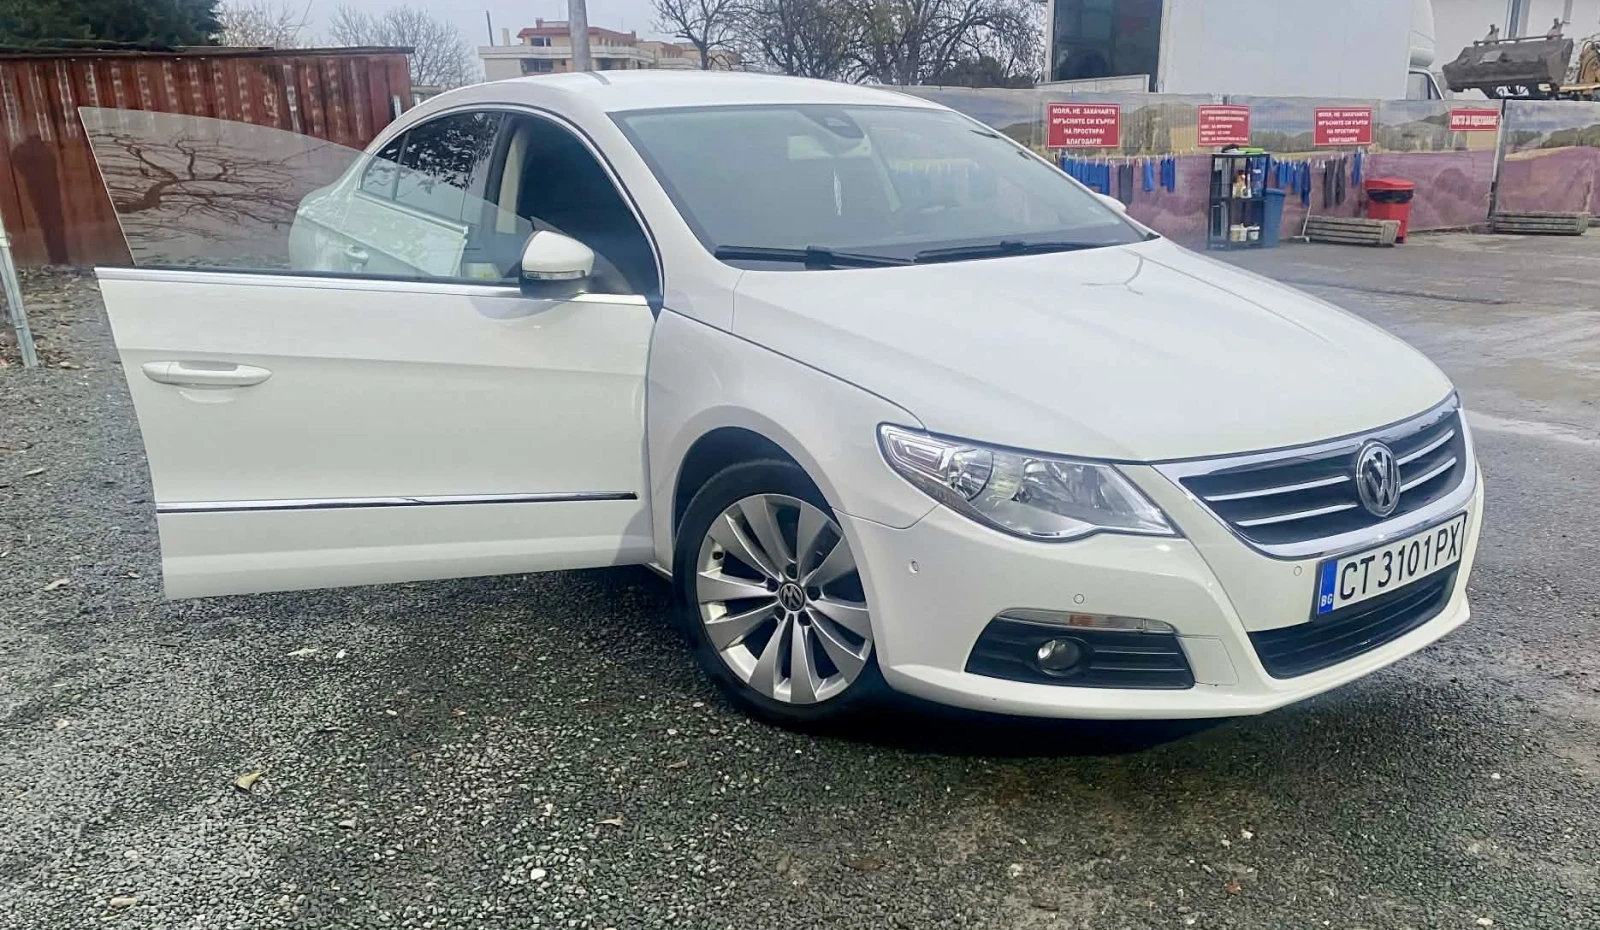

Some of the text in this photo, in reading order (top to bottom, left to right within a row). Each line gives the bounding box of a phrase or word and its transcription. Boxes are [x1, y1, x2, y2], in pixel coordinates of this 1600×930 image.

[1339, 521, 1461, 600] CT 3101 PX
[1320, 593, 1333, 607] BG
